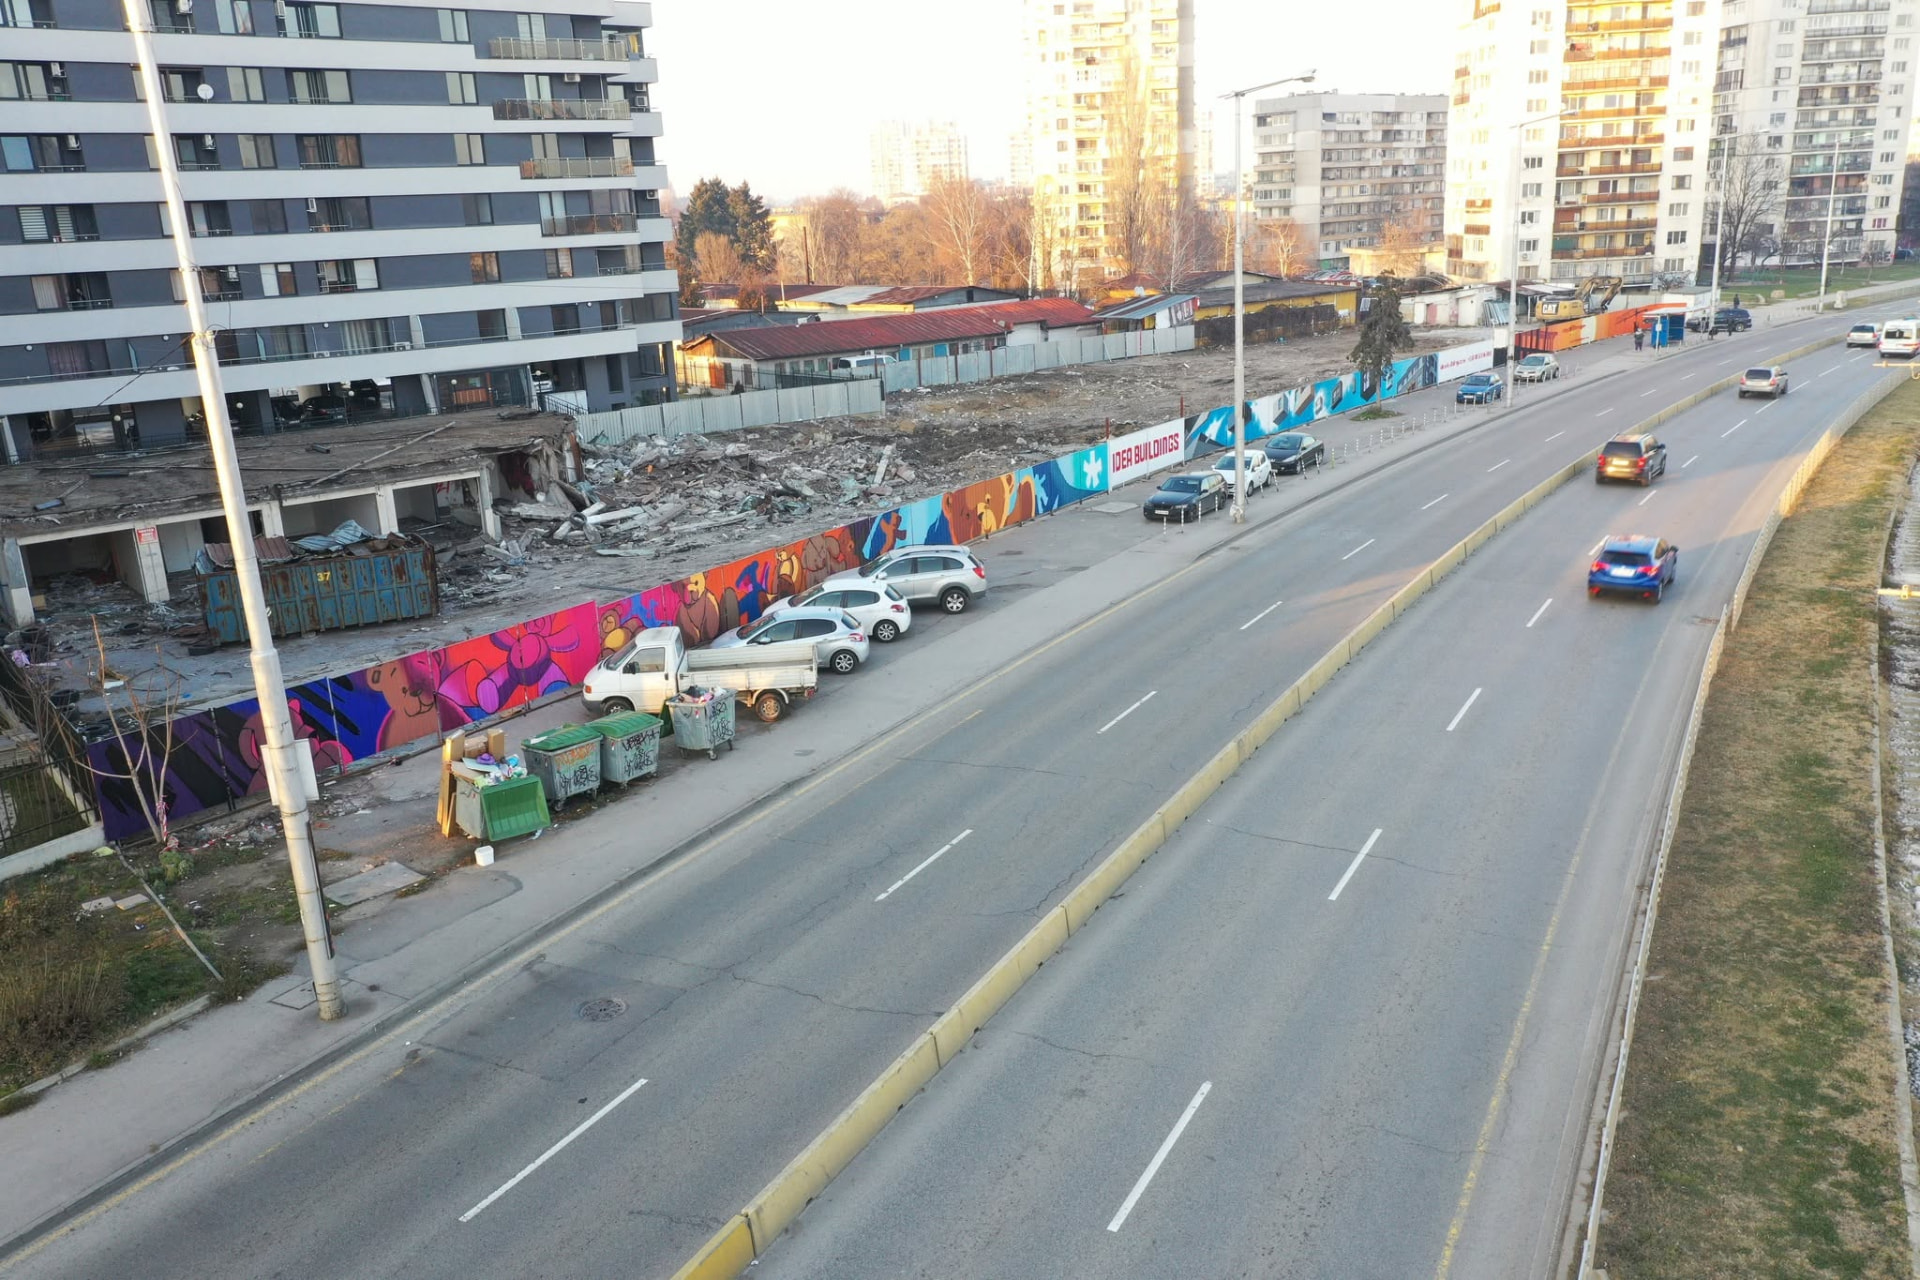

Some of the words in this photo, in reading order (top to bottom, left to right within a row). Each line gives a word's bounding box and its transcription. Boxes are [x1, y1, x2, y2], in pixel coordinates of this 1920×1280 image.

[1542, 303, 1557, 314] CAT
[1112, 447, 1133, 473] IDEA
[1134, 432, 1179, 465] BUILDINGS
[316, 571, 331, 582] 37
